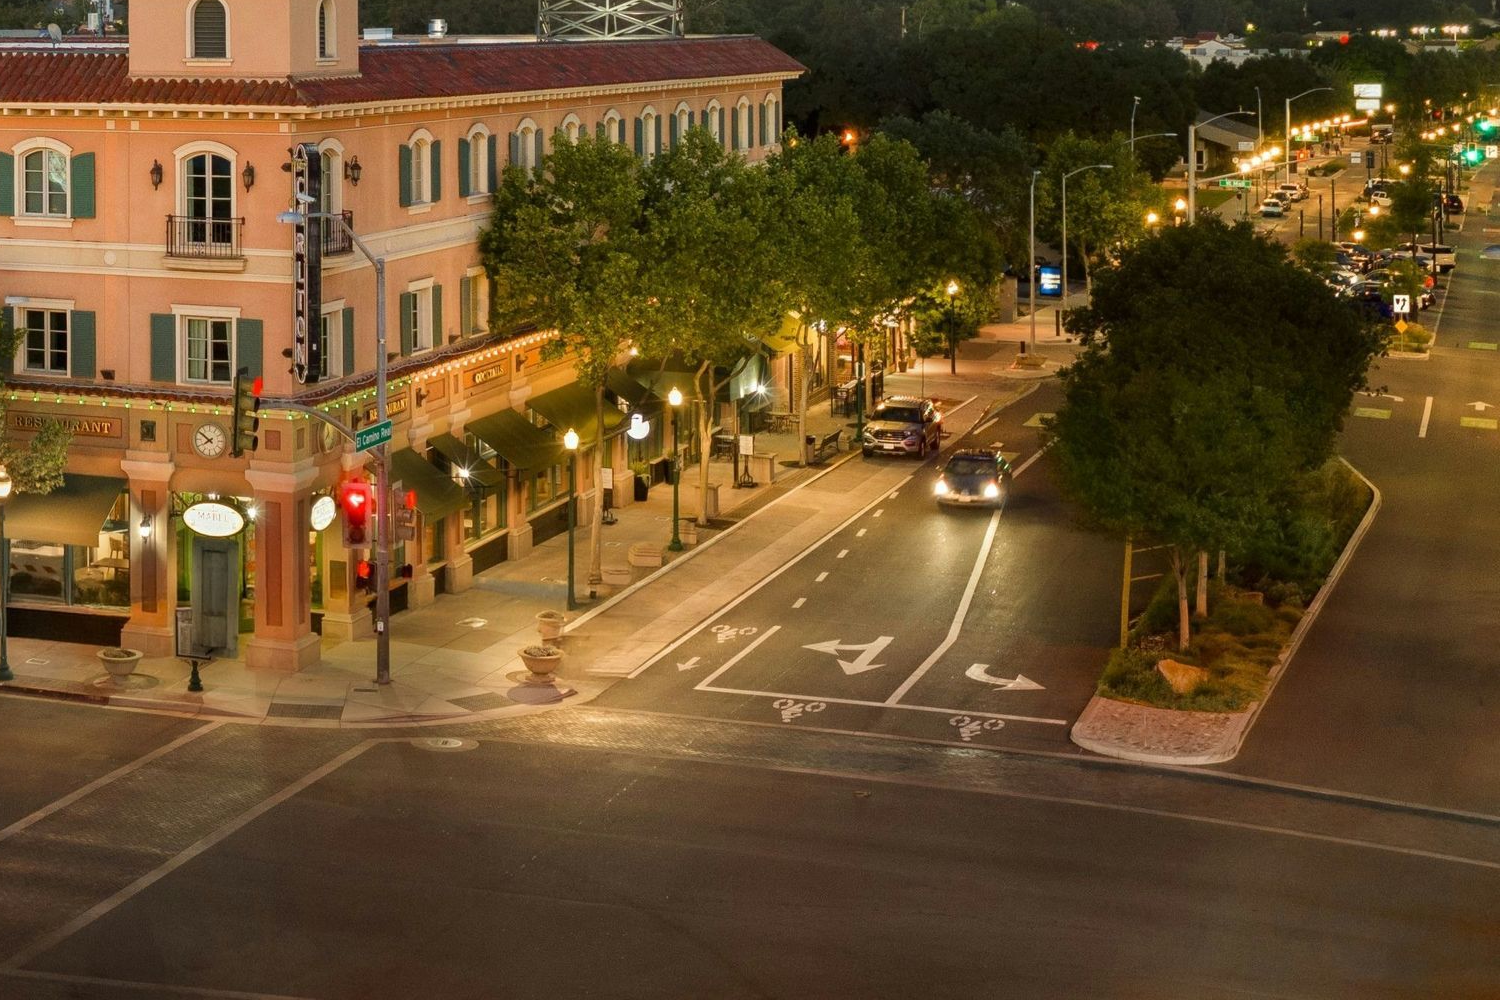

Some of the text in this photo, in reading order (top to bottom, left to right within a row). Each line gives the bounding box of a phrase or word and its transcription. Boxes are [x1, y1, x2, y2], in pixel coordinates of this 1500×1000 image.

[356, 427, 391, 448] El Camino Real
